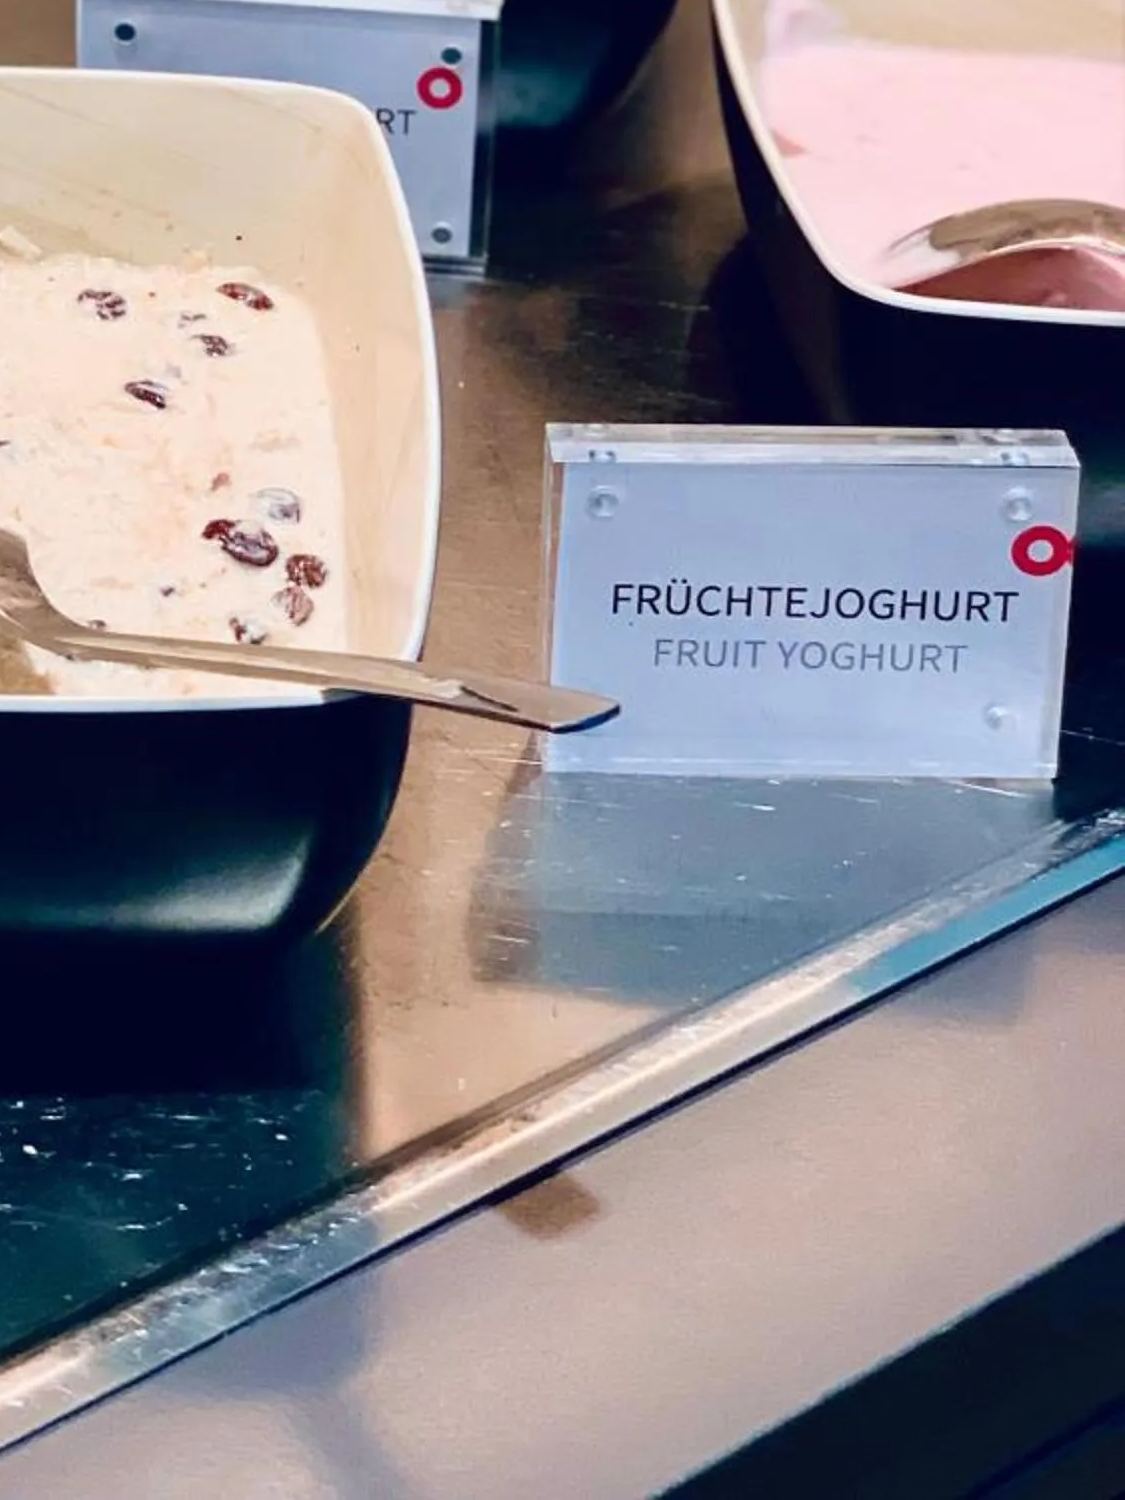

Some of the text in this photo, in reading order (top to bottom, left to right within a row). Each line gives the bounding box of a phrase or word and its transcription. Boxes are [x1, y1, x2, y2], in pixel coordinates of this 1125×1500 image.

[611, 577, 1020, 623] FRÜCHTEJOGHURT
[653, 638, 968, 674] FRUIT YOGHURT
